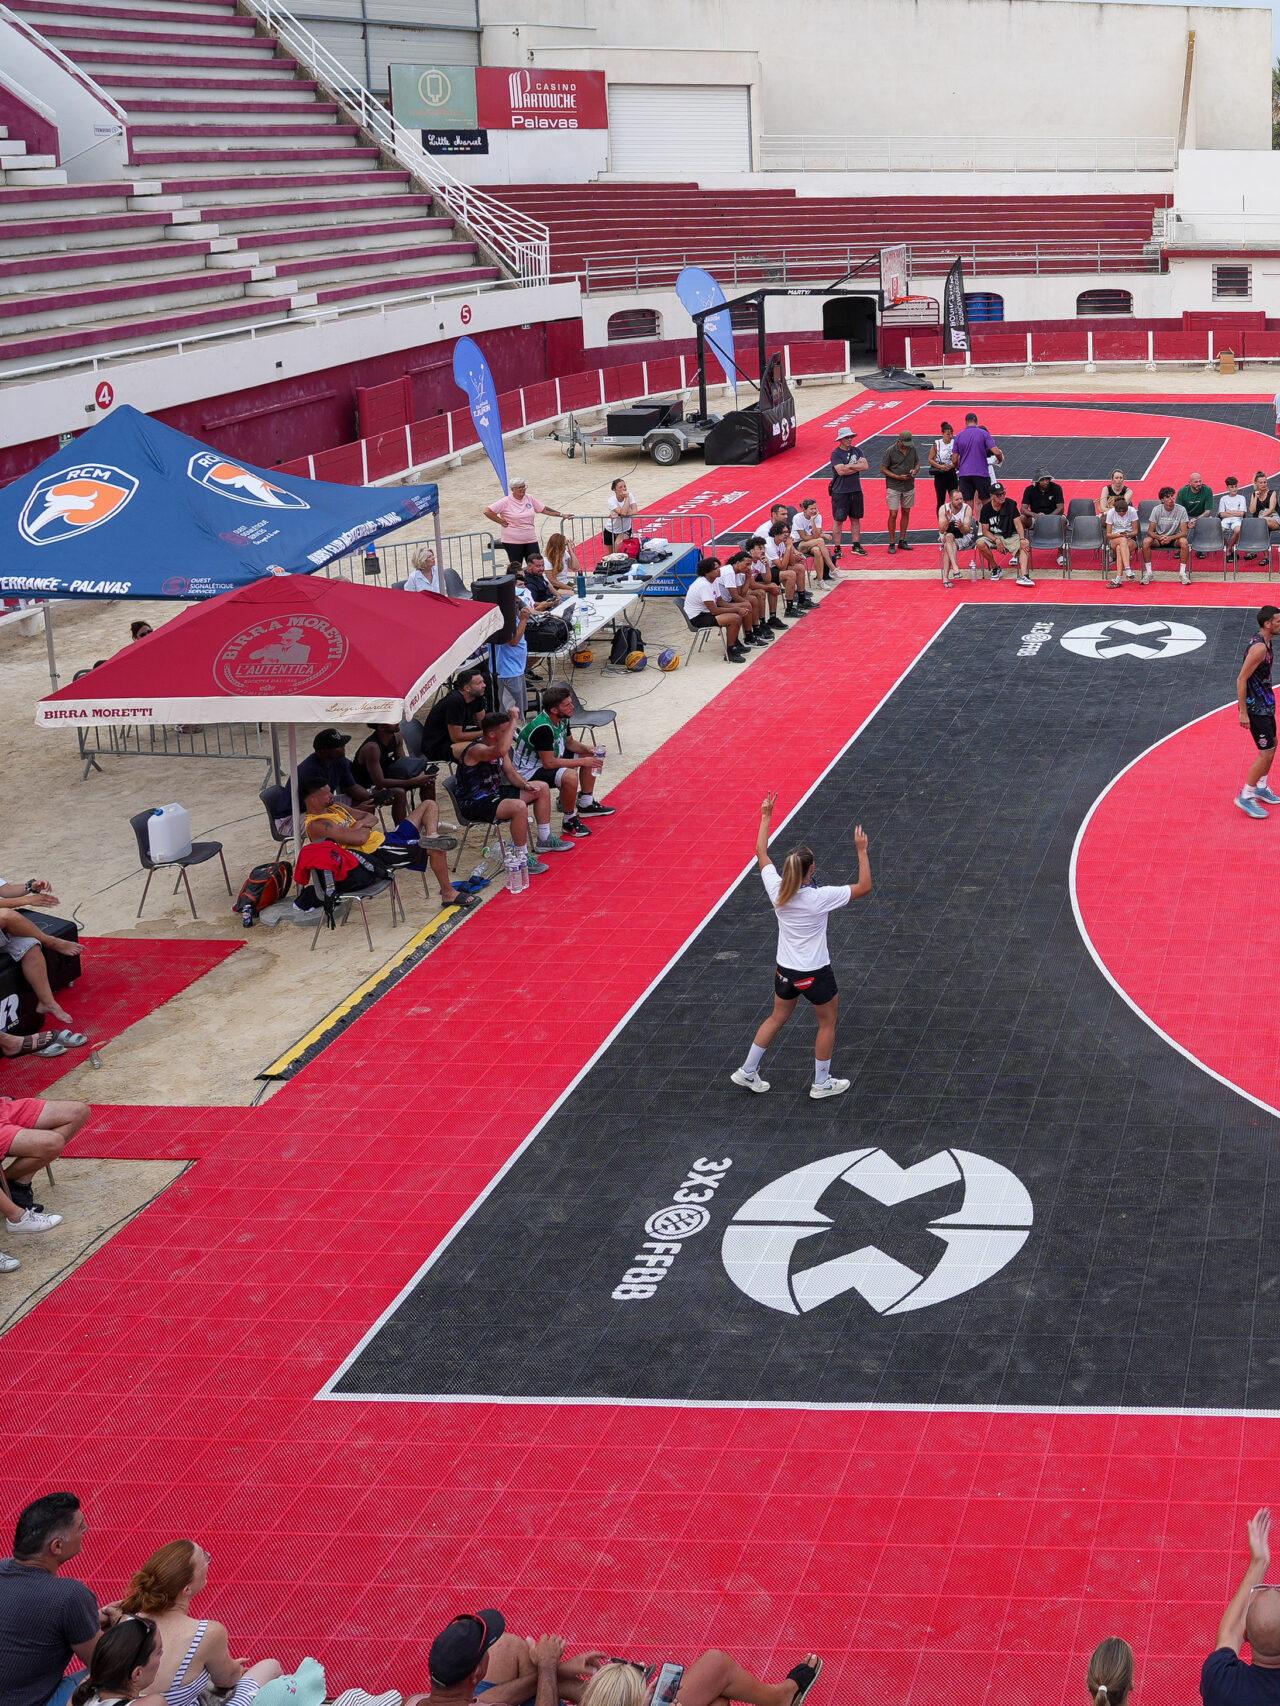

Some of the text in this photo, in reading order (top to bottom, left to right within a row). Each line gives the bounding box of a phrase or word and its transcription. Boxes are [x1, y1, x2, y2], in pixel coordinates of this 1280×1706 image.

[535, 82, 577, 92] CASINO
[511, 115, 578, 129] Palavas
[66, 468, 112, 481] RCM
[0, 577, 62, 592] ERRANÉE
[70, 580, 132, 594] PALAVAS
[222, 616, 343, 660] BIRRA MORETTI
[235, 664, 315, 675] L'AUTENTICA
[44, 708, 153, 719] BIRRA MORETTI
[672, 1156, 733, 1203] 3X3
